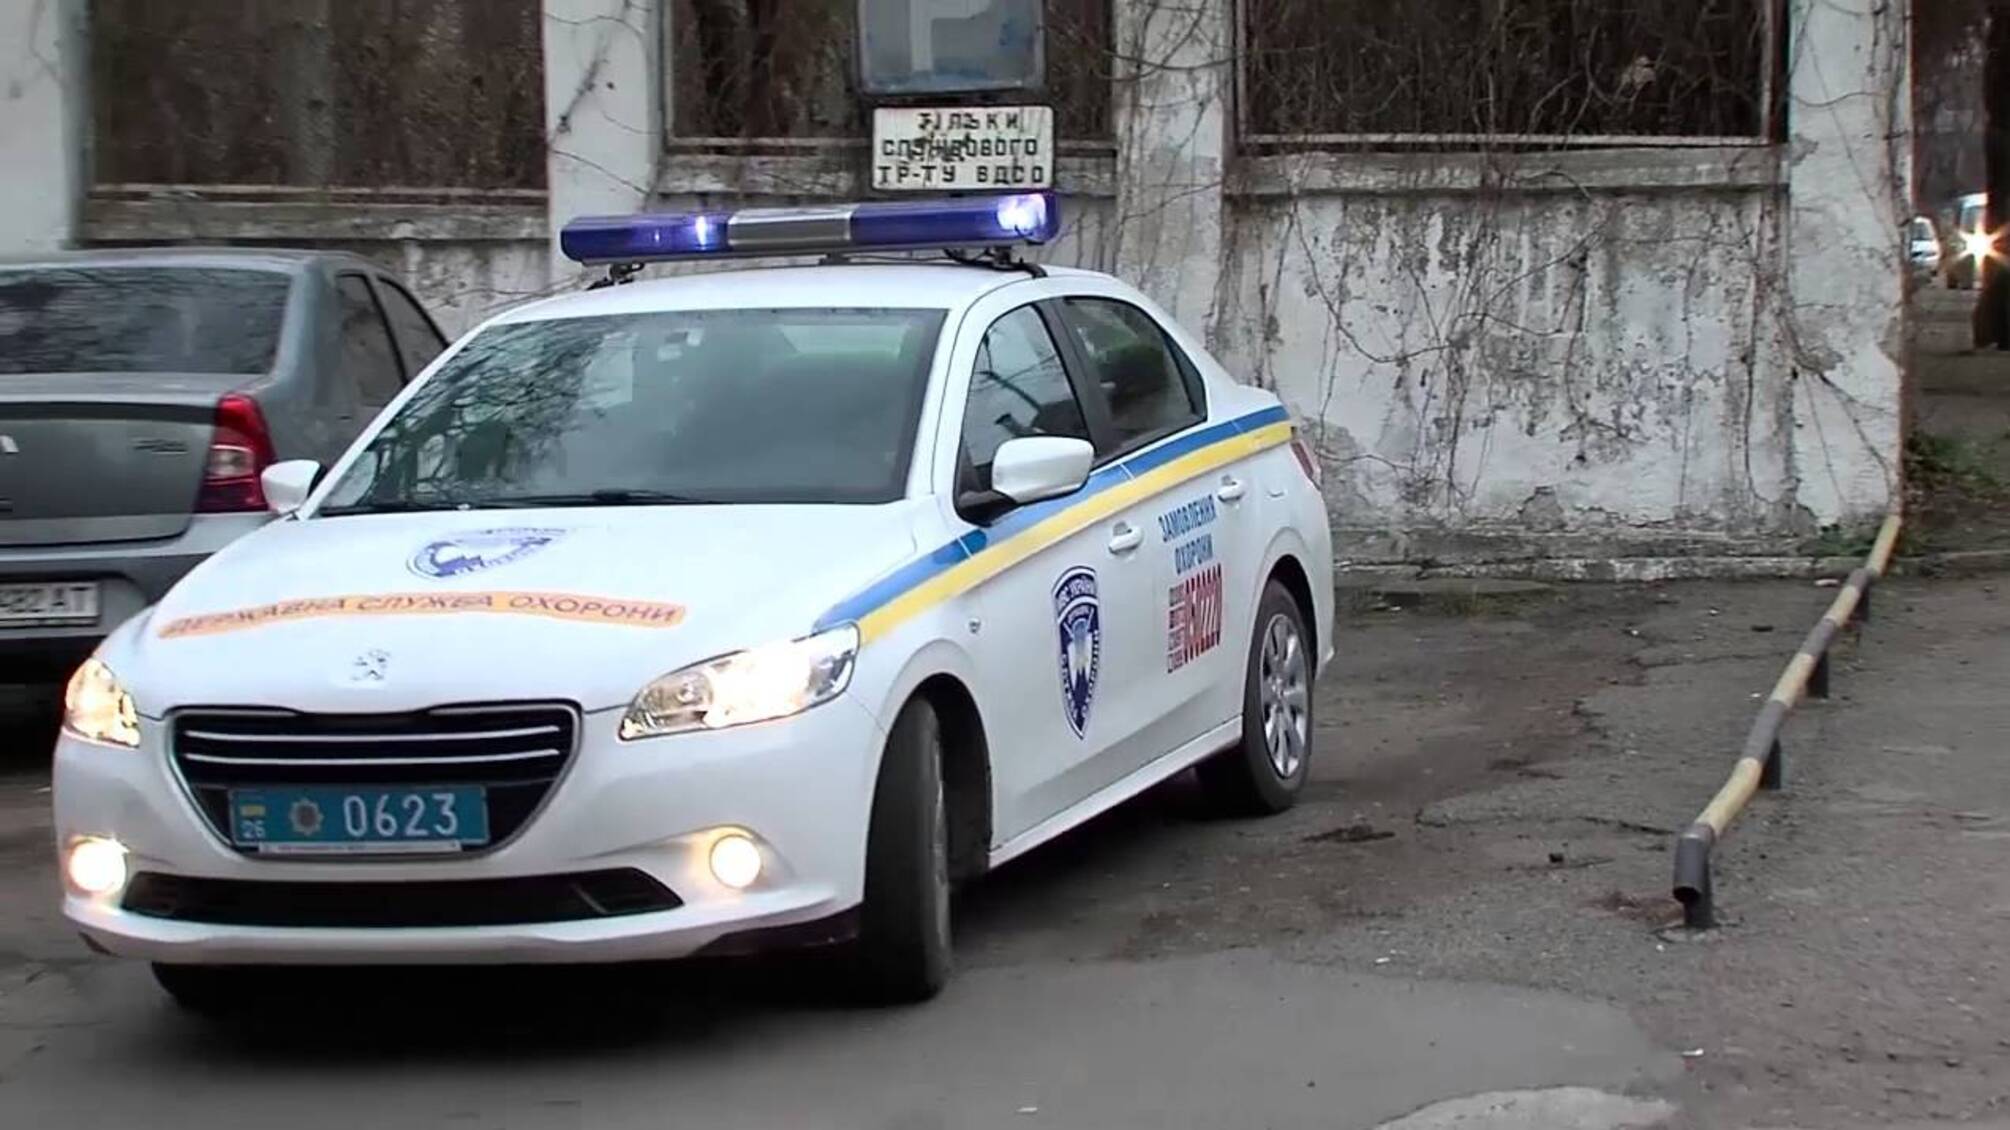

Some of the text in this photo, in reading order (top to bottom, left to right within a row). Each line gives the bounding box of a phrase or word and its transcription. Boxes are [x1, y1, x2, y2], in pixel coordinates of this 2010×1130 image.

[877, 165, 1044, 184] ТР-ТУ ВДСО
[1175, 534, 1213, 574] ОХОРОНИ
[357, 596, 493, 611] СЛУЖБА
[509, 595, 677, 622] ОХОРОНИ
[343, 793, 458, 837] 0623
[240, 819, 266, 839] 26
